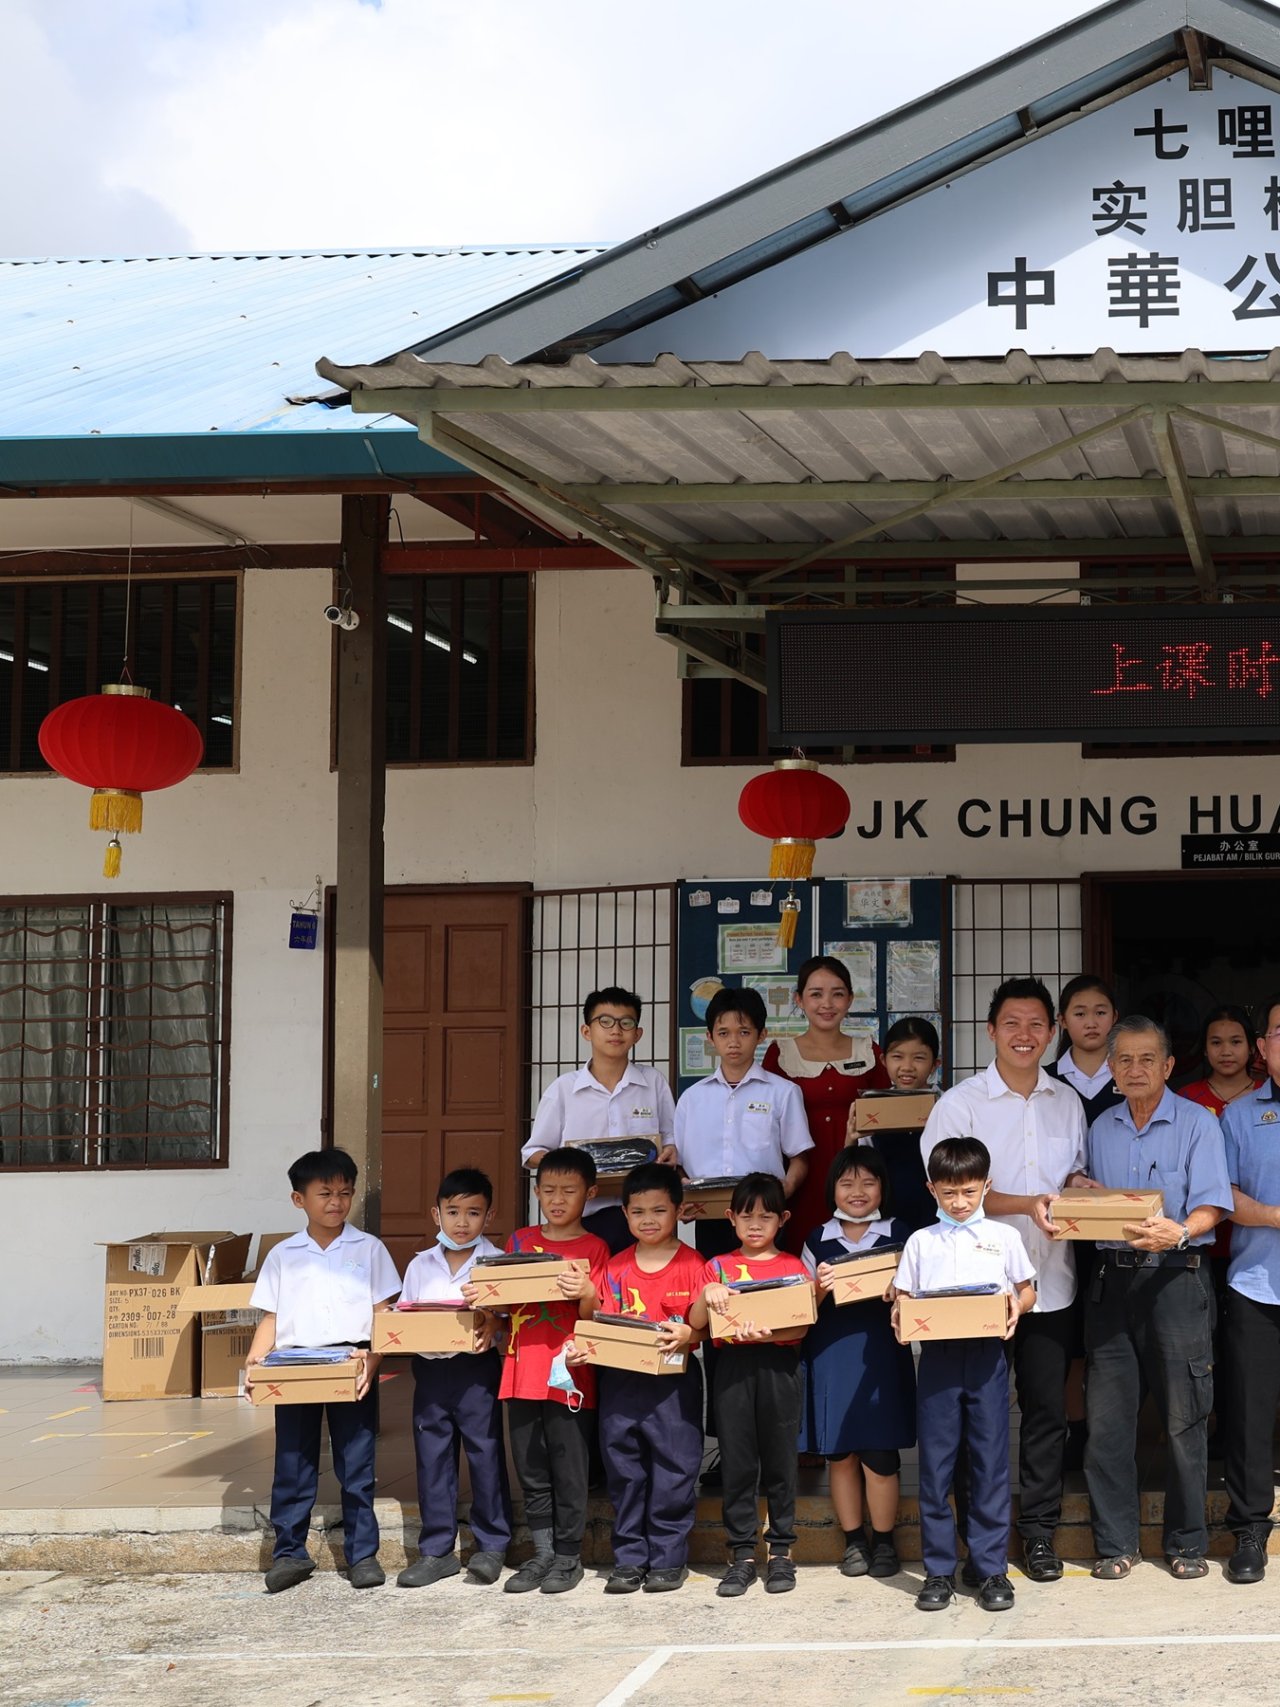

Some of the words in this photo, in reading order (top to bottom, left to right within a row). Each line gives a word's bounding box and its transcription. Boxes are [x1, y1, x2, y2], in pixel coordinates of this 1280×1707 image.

[1133, 105, 1276, 159] 七哩
[827, 799, 928, 840] JK
[957, 795, 1158, 838] CHUNG
[1219, 840, 1259, 852] 办公室
[1193, 853, 1225, 862] PEJABAT
[1226, 853, 1238, 861] AM
[1244, 852, 1263, 861] BILIK
[170, 1287, 181, 1296] BK
